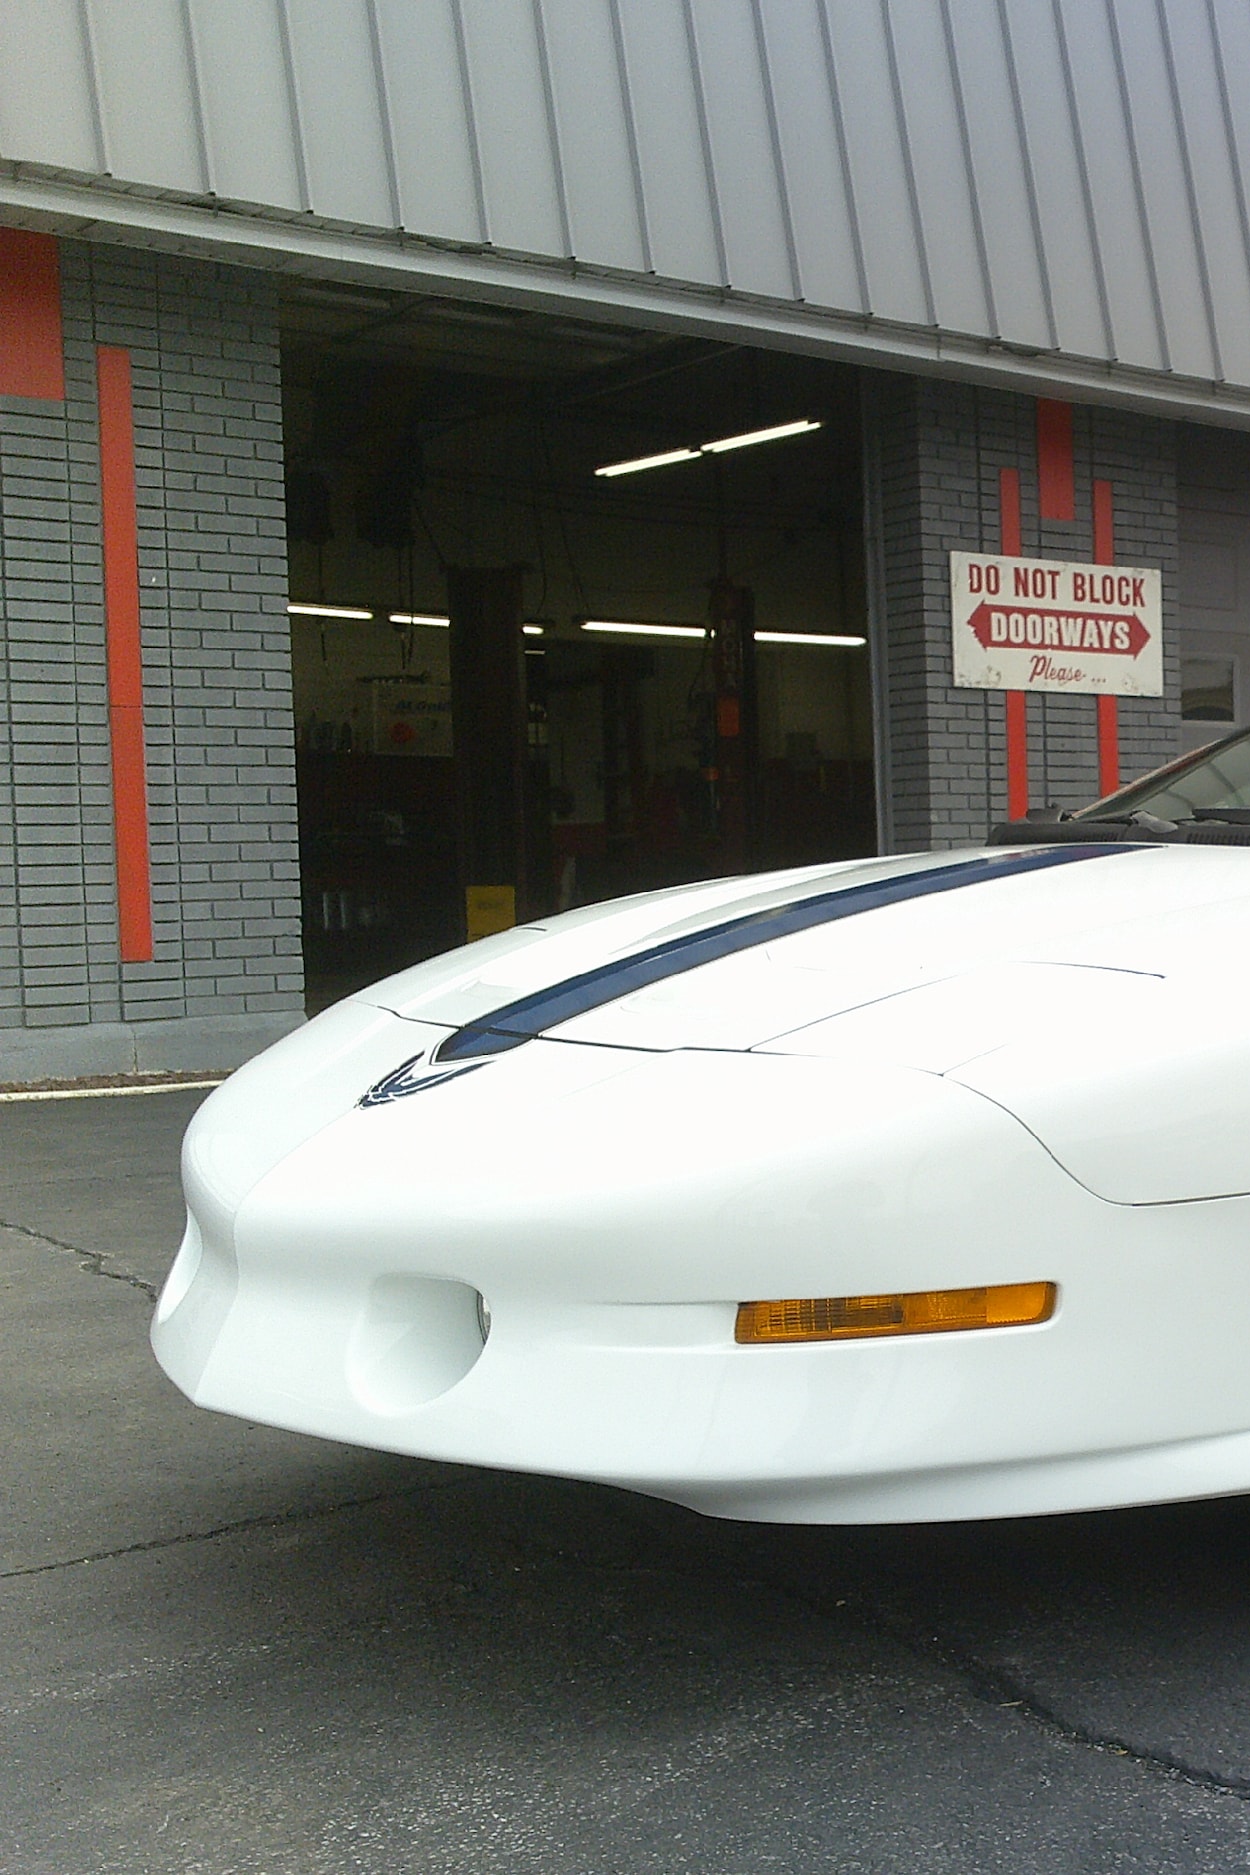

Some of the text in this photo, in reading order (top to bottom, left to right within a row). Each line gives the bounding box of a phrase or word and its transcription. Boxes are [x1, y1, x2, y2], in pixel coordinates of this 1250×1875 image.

[968, 563, 1145, 607] DO NOT BLOCK
[990, 612, 1131, 649] DOORWAYS
[1028, 655, 1085, 683] Please
